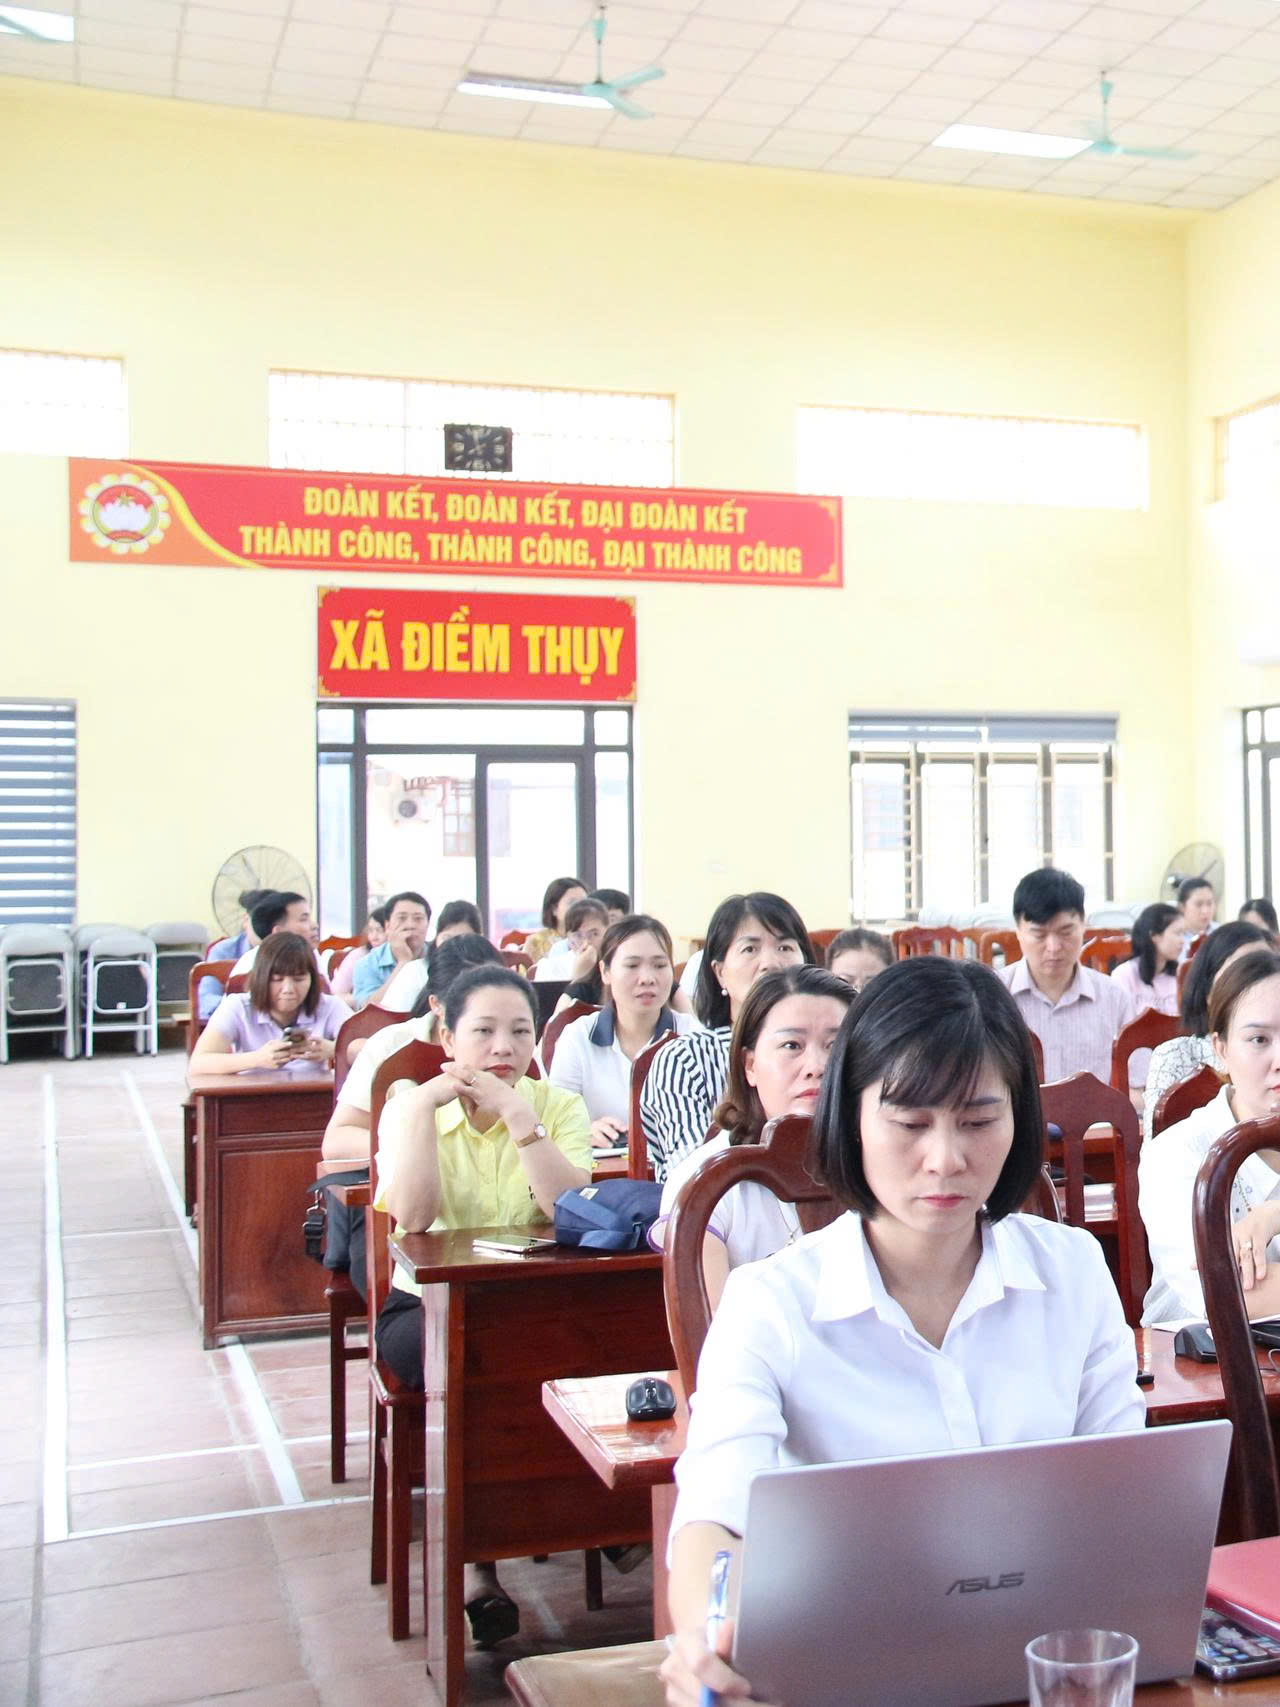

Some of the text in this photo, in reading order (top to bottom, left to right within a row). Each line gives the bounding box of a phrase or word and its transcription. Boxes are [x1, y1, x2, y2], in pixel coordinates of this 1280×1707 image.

[304, 483, 748, 534] ĐOÀN KẾT, ĐOÀN KẾT, ĐẠI ĐOÀN KẾT
[239, 521, 803, 575] THÀNH CÔNG, THÀNH CÔNG, ĐẠI THÀNH CÔNG
[329, 605, 625, 686] XÃ ĐIỀM THỤY
[944, 1571, 1024, 1596] ASUS
